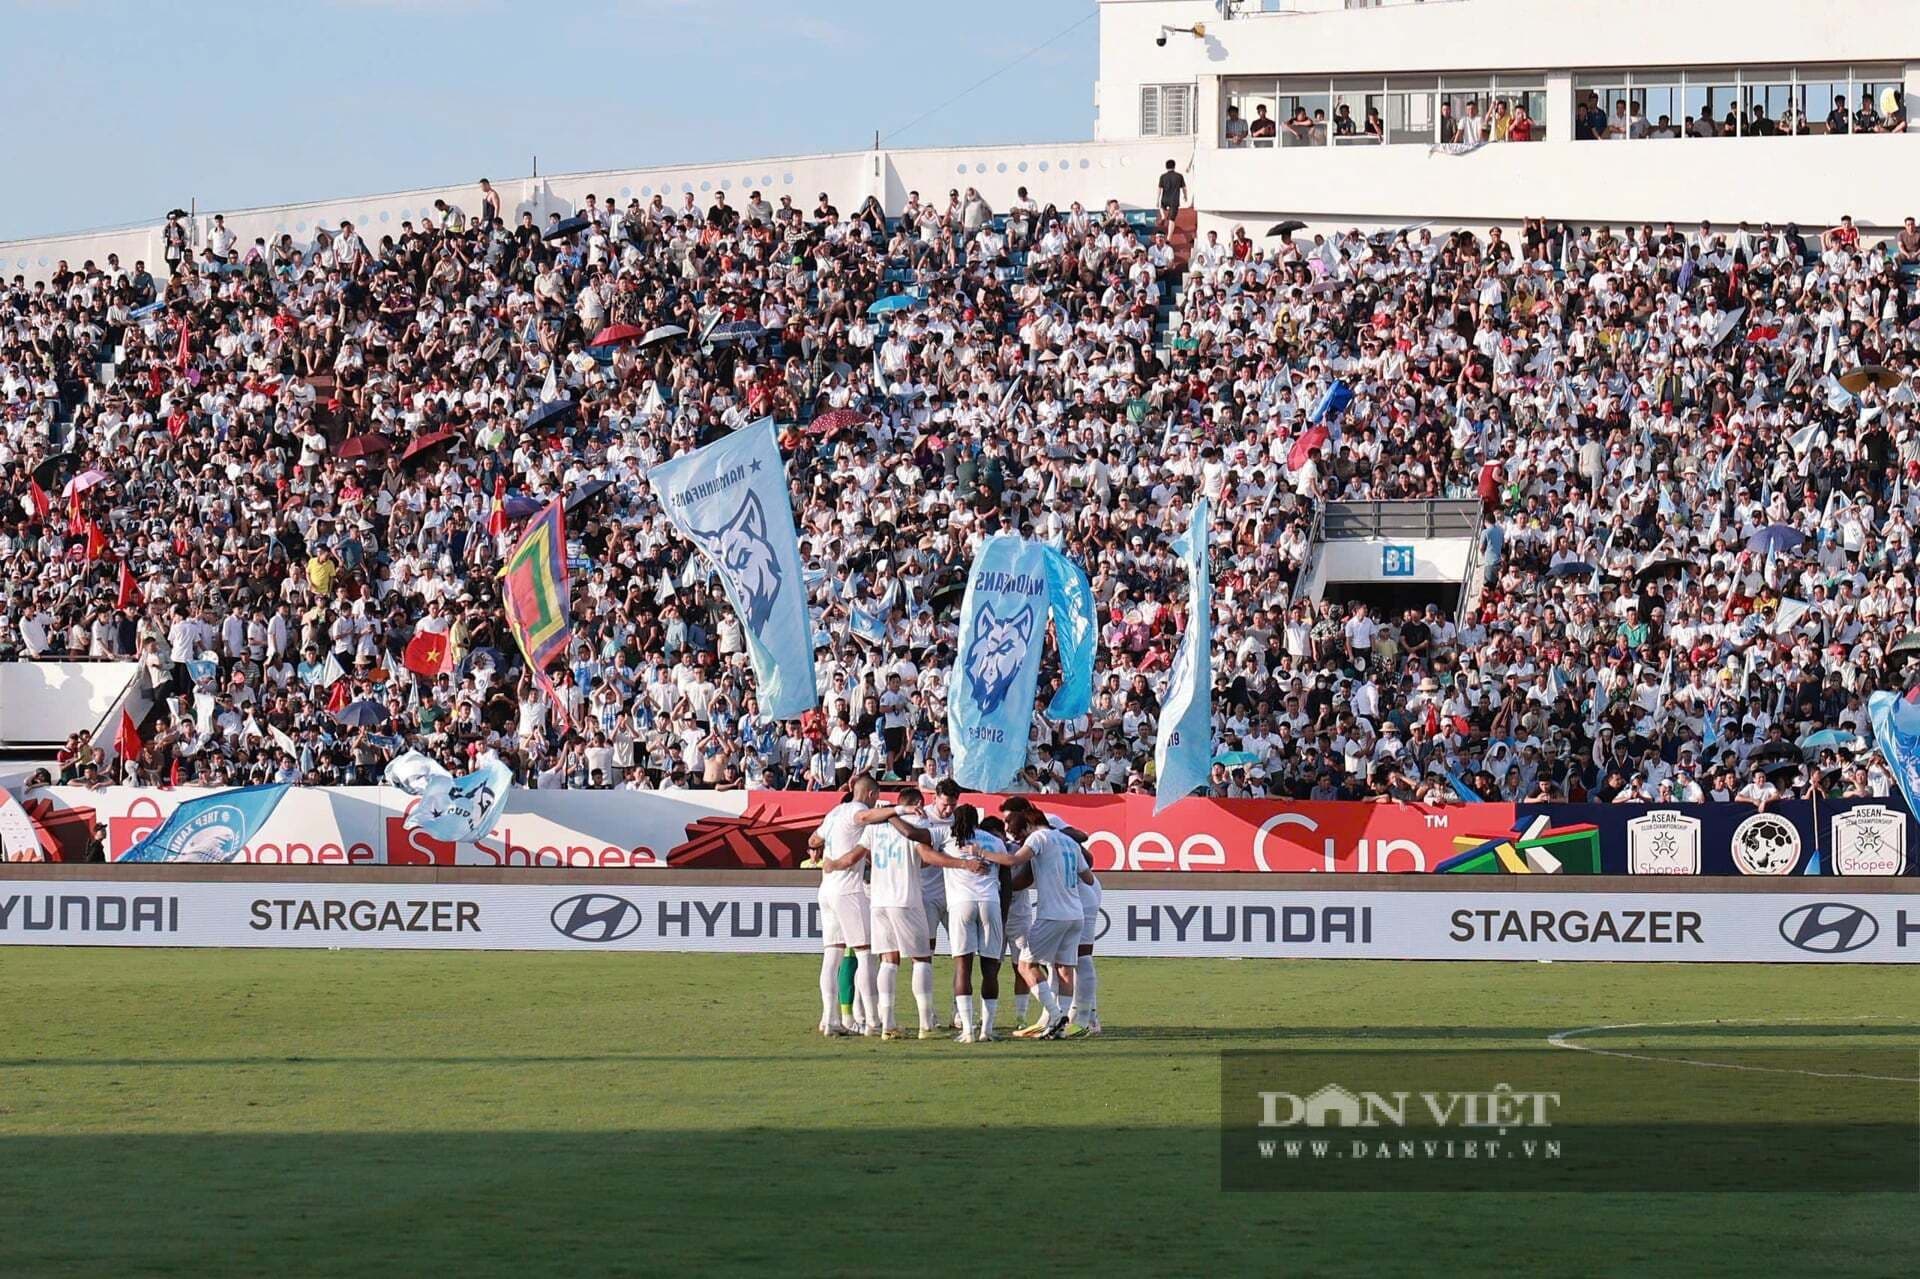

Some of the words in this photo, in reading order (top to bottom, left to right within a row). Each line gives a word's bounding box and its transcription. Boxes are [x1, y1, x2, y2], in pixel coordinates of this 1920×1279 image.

[1387, 550, 1411, 572] B1
[1651, 813, 1677, 823] ASEAN
[1856, 808, 1882, 818] ASEAN
[1844, 858, 1894, 872] Shopee
[250, 899, 481, 933] STARGAZER
[1127, 905, 1372, 943] HYUNDAI
[1449, 909, 1704, 944] STARGAZER
